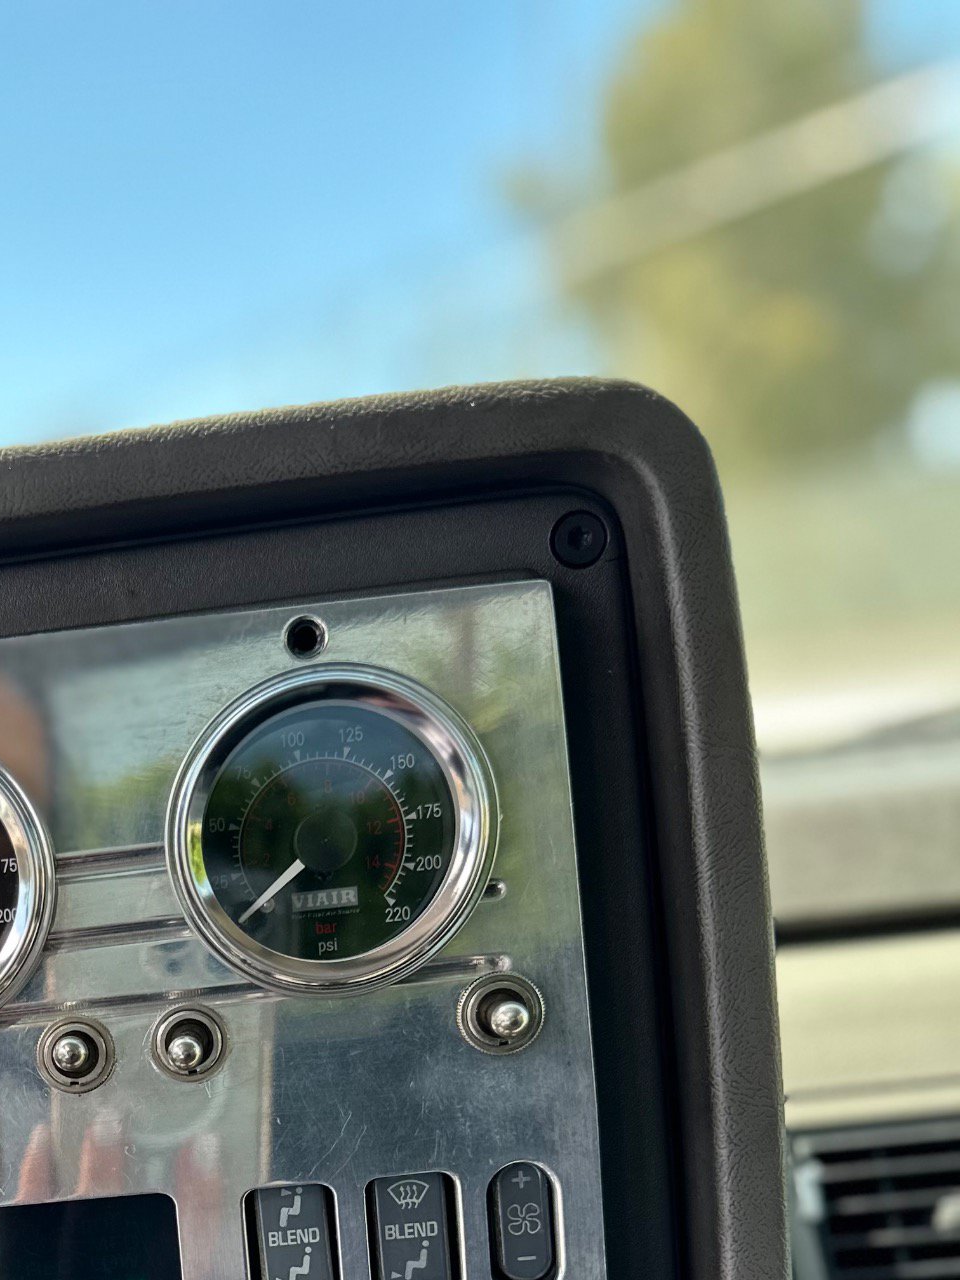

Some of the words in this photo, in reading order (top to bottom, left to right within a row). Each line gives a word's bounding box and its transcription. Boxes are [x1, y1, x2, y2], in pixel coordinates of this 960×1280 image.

[280, 733, 305, 747] 100
[340, 726, 363, 743] 125
[390, 753, 415, 770] 150
[417, 803, 442, 819] 175
[209, 817, 226, 833] 50
[366, 820, 382, 835] 12
[365, 855, 380, 868] 14
[416, 855, 442, 871] 200
[291, 888, 357, 909] VIAIR
[385, 906, 411, 923] 220
[316, 922, 337, 935] bar
[318, 938, 338, 956] psi
[268, 1226, 320, 1247] BLEND
[384, 1220, 438, 1241] BLEND
